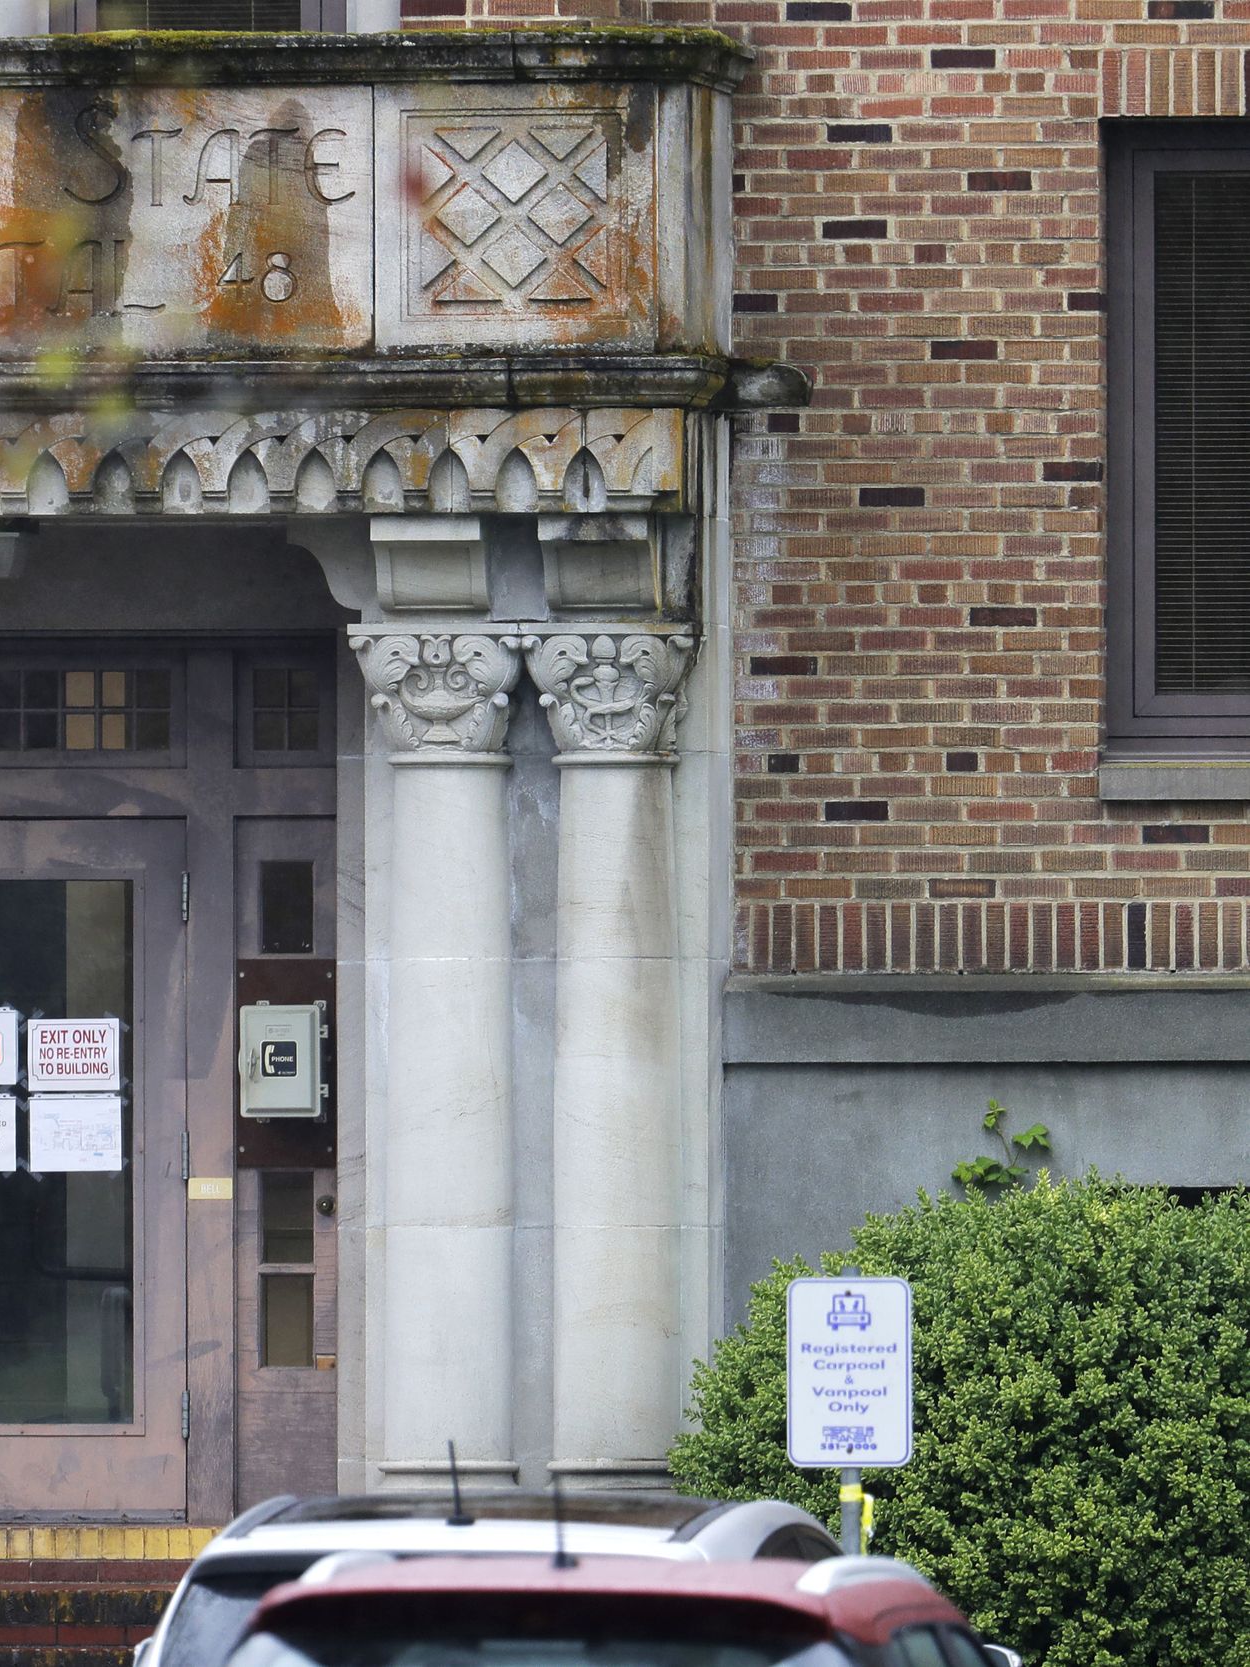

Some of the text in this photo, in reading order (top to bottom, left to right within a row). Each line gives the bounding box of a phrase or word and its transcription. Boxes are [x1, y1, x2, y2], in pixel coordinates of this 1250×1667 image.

[63, 97, 356, 208] STATE
[217, 250, 298, 304] 48
[40, 1030, 106, 1044] EXIT ONLY
[39, 1047, 107, 1059] NO RE-ENTRY
[39, 1063, 109, 1074] TO BUILDING
[801, 1343, 897, 1356] Registered
[813, 1360, 885, 1372] Carpool
[845, 1376, 854, 1384] &
[812, 1387, 887, 1399] Vanpool
[828, 1402, 869, 1414] Only
